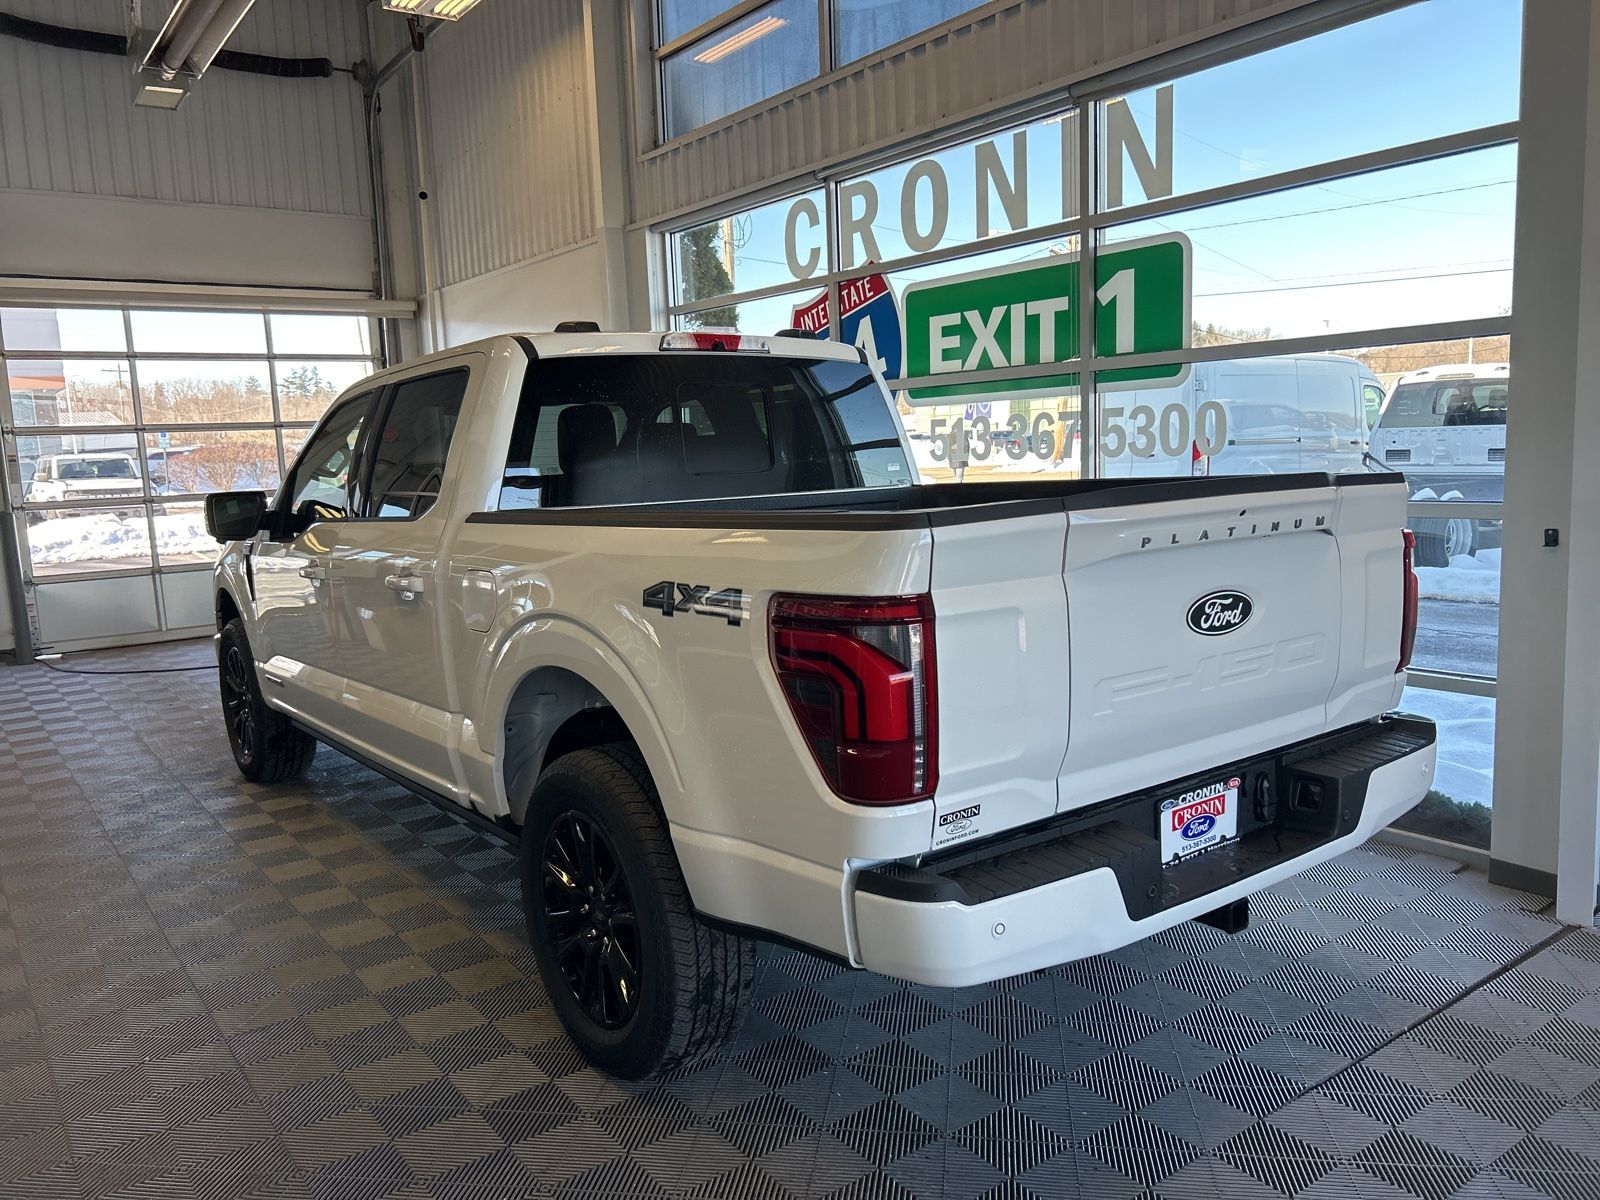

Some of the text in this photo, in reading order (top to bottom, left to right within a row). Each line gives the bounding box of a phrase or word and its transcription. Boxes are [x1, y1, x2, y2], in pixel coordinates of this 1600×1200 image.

[785, 84, 1173, 279] CRONIN
[800, 276, 873, 331] INTETATE
[929, 268, 1135, 374] EXIT 1
[1141, 516, 1325, 549] PLATINUM
[1200, 597, 1243, 629] Ford
[1093, 632, 1327, 717] F-150
[1179, 782, 1224, 806] CRONIN
[940, 805, 980, 825] CRONIN
[1174, 797, 1224, 829] CRONIN
[1187, 818, 1210, 837] Ford
[936, 828, 980, 846] CRONINFORD.COM
[1181, 834, 1217, 853] 513-367-5300
[1181, 850, 1200, 863] EXIT
[1207, 837, 1240, 852] Harrison
